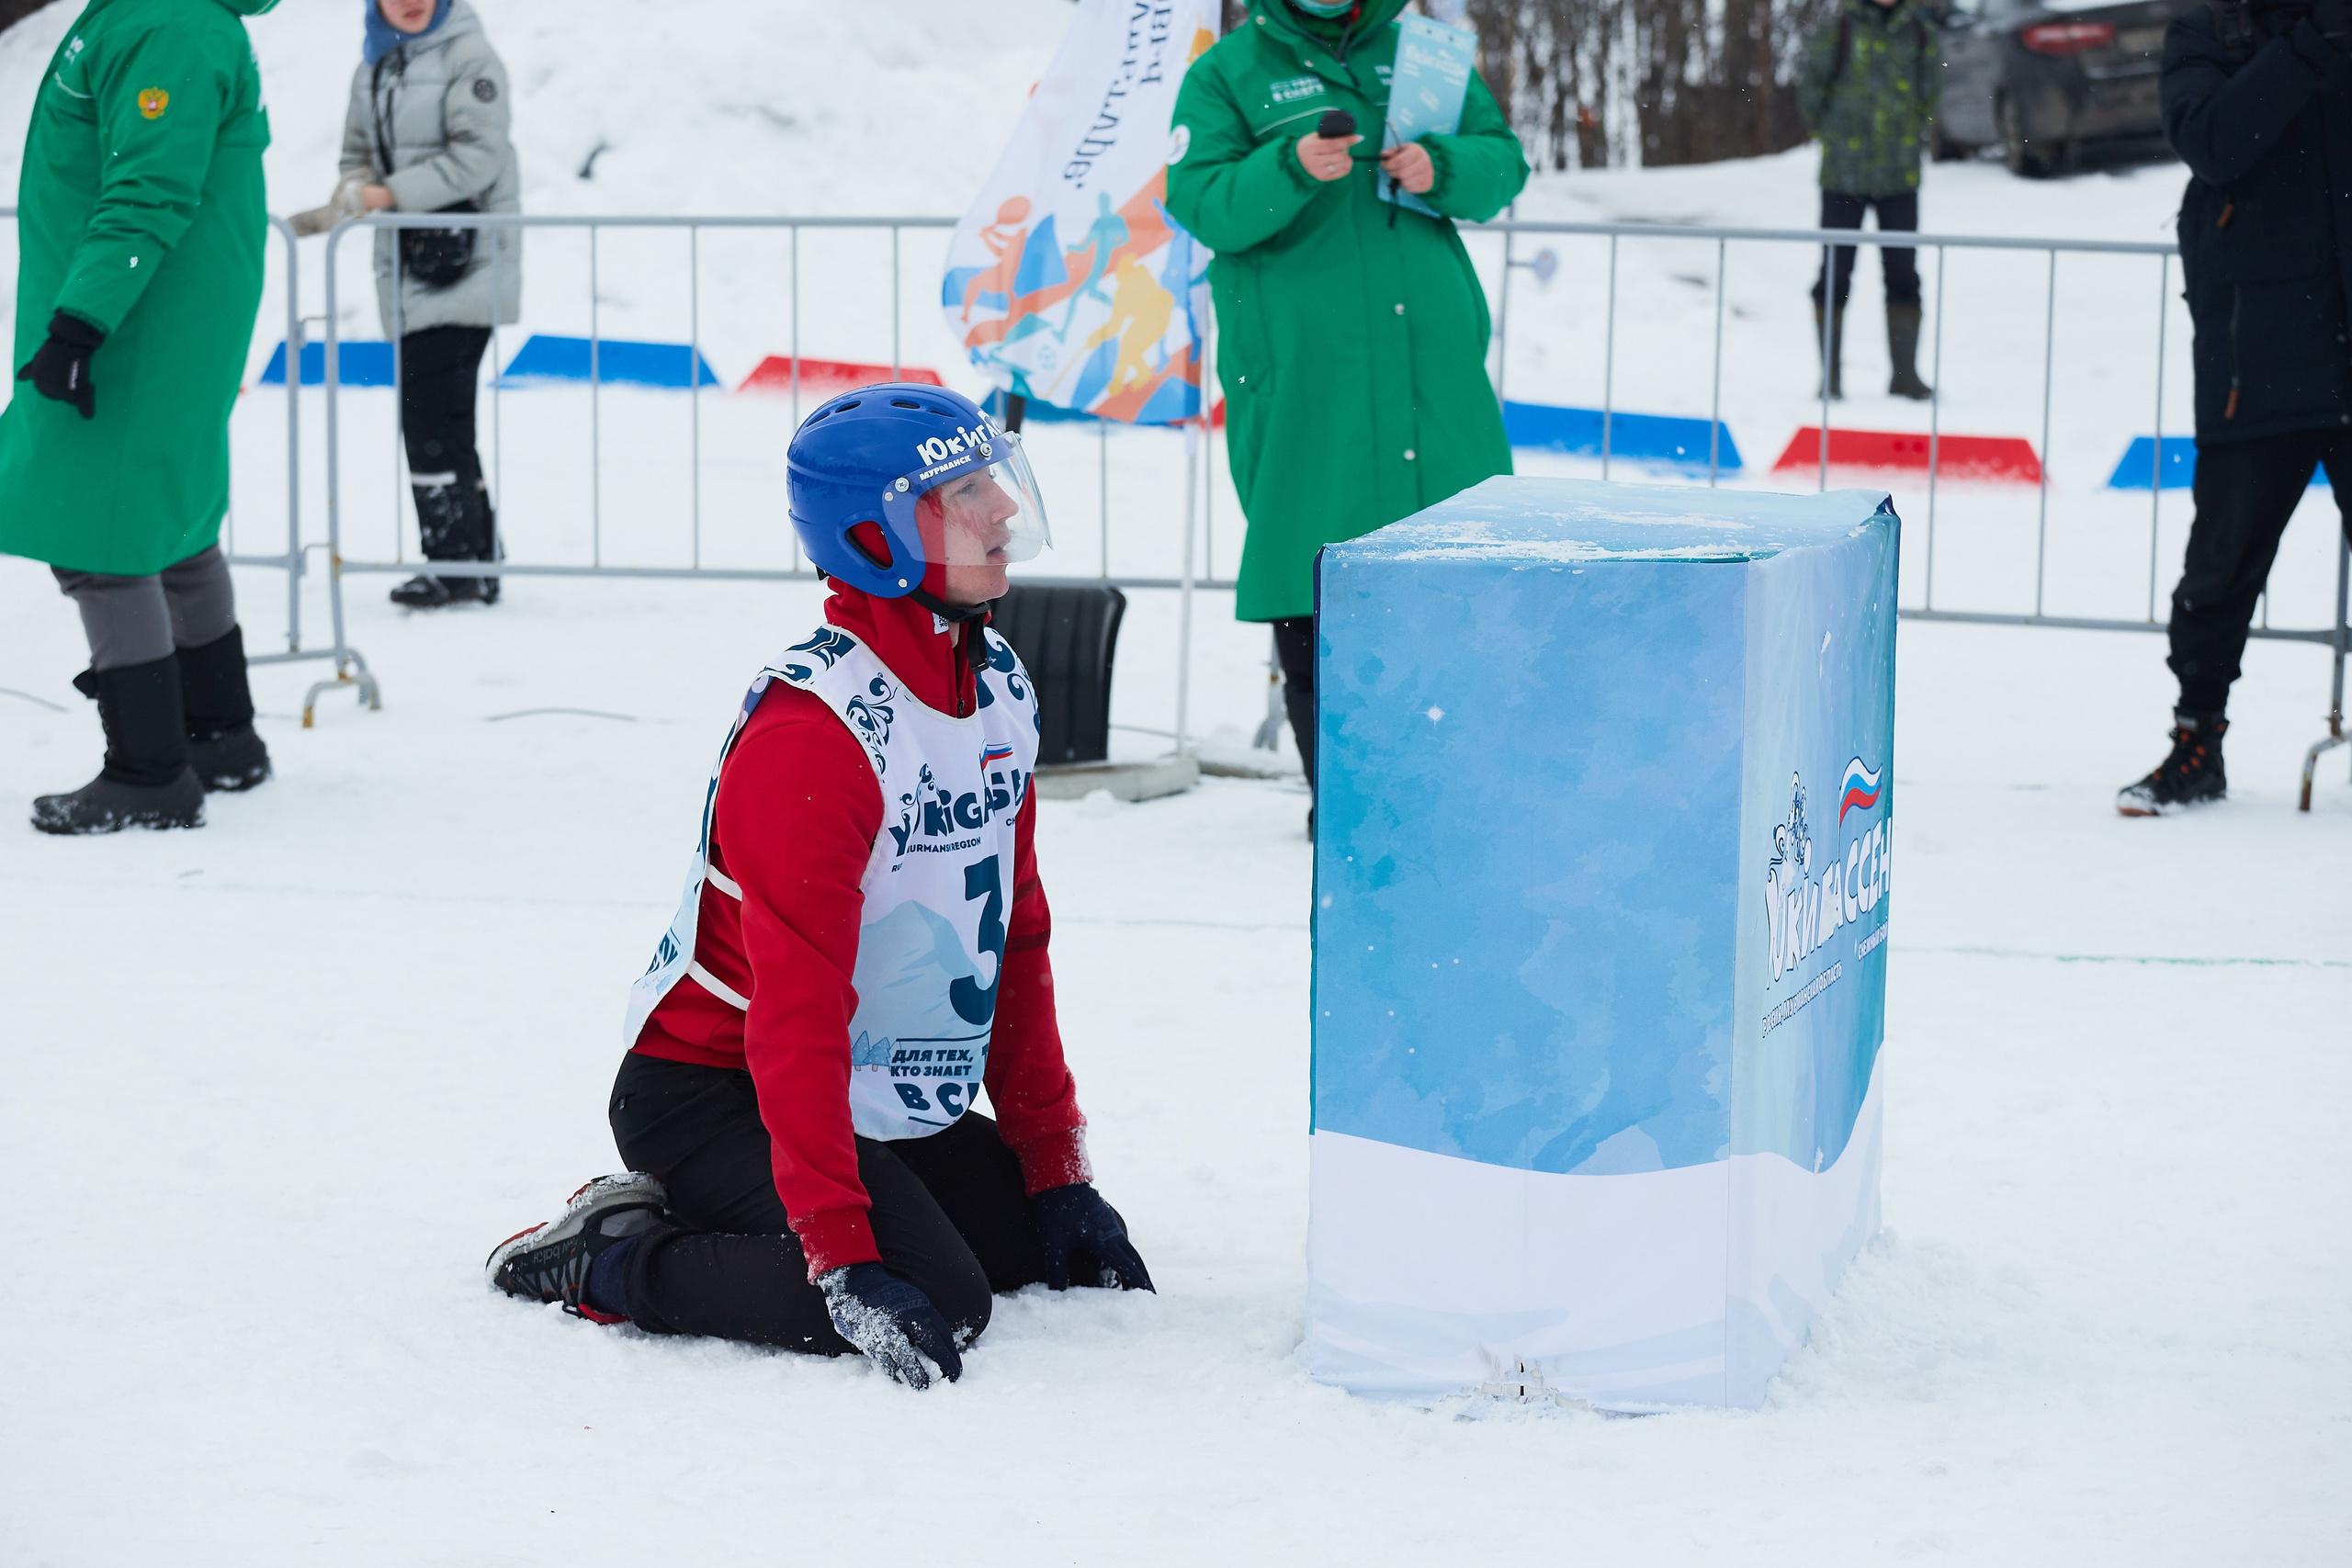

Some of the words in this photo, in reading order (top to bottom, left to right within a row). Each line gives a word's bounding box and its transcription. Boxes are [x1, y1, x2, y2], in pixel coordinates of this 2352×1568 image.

[919, 455, 972, 480] МУРМАНСК
[949, 853, 1006, 1026] 3
[891, 1049, 933, 1064] ДЛЯ
[935, 1049, 974, 1063] ТЕХ,
[890, 1066, 922, 1077] КТО
[922, 1065, 972, 1077] ЗНАЕТ
[893, 1083, 932, 1111] В
